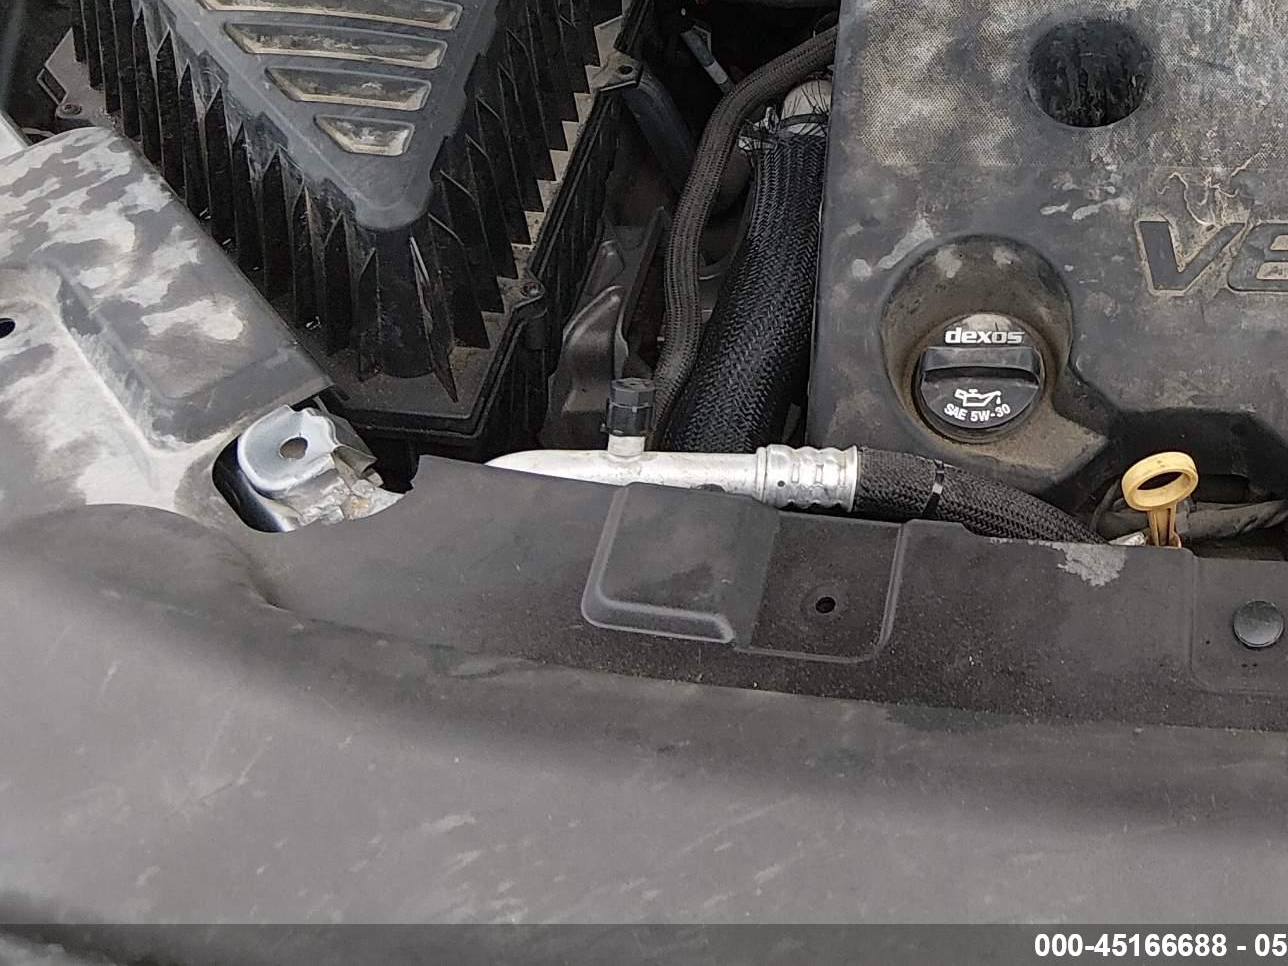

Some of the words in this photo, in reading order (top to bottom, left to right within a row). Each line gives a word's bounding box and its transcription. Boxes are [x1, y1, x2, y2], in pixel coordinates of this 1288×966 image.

[945, 327, 1025, 345] dexos
[943, 403, 968, 422] SAE
[970, 403, 1011, 423] 5W-30
